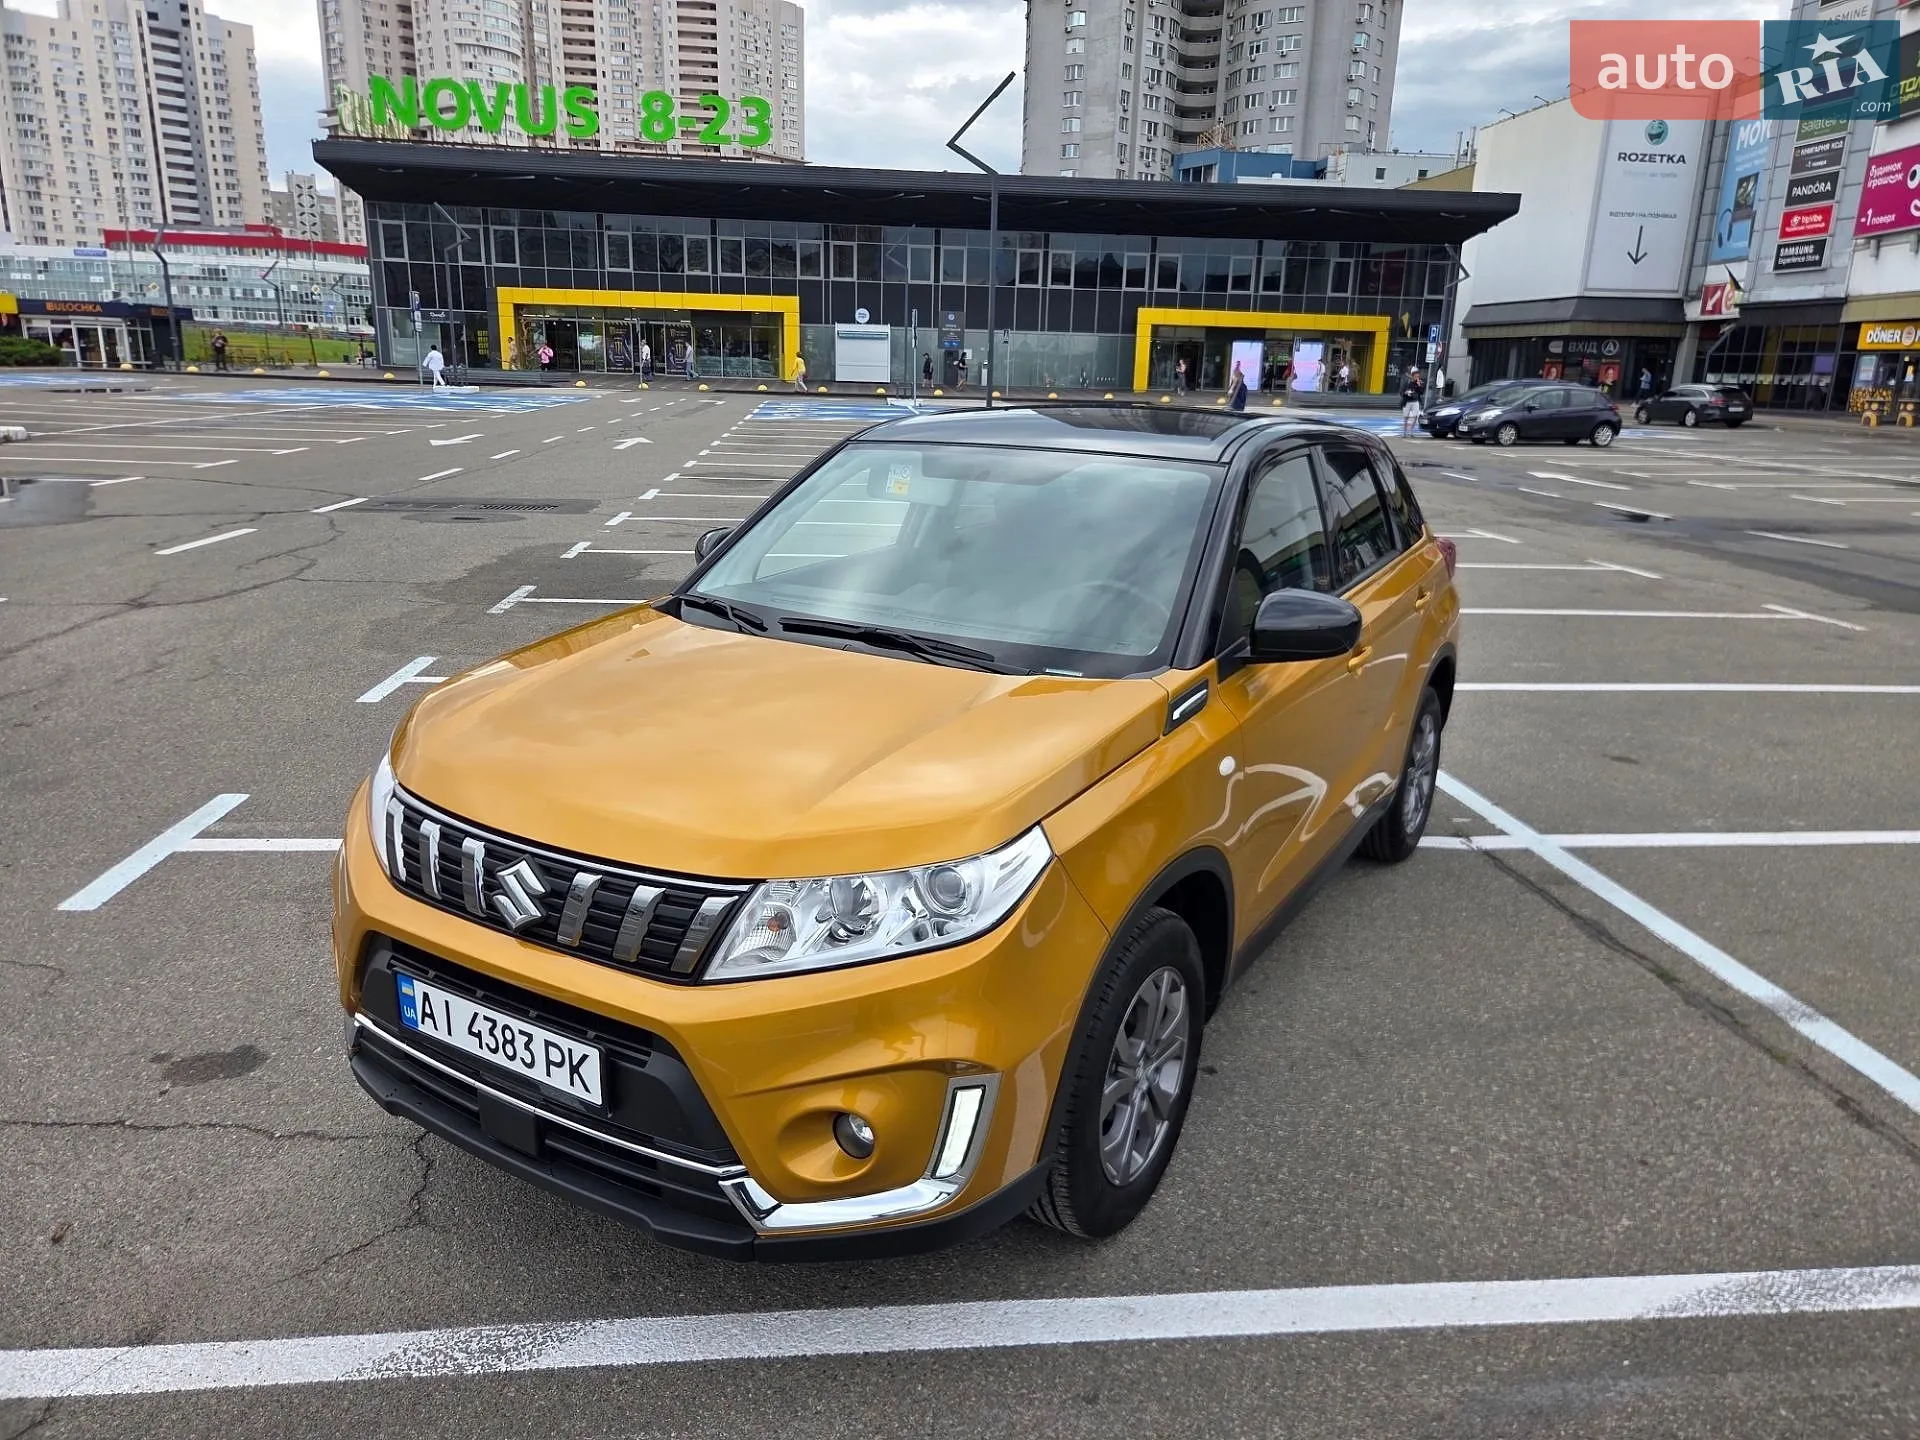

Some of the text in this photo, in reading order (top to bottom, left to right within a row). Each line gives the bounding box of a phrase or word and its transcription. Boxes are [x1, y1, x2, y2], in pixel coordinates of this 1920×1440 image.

[368, 73, 599, 138] NOVUS
[640, 90, 772, 147] 8-23
[1617, 152, 1687, 165] ROZETKA
[1780, 244, 1814, 257] SAMSUNG
[1866, 325, 1902, 343] DÖNER
[1568, 340, 1598, 353] ВХІД
[404, 1005, 417, 1020] UA
[420, 991, 592, 1094] AI 4383 PK
